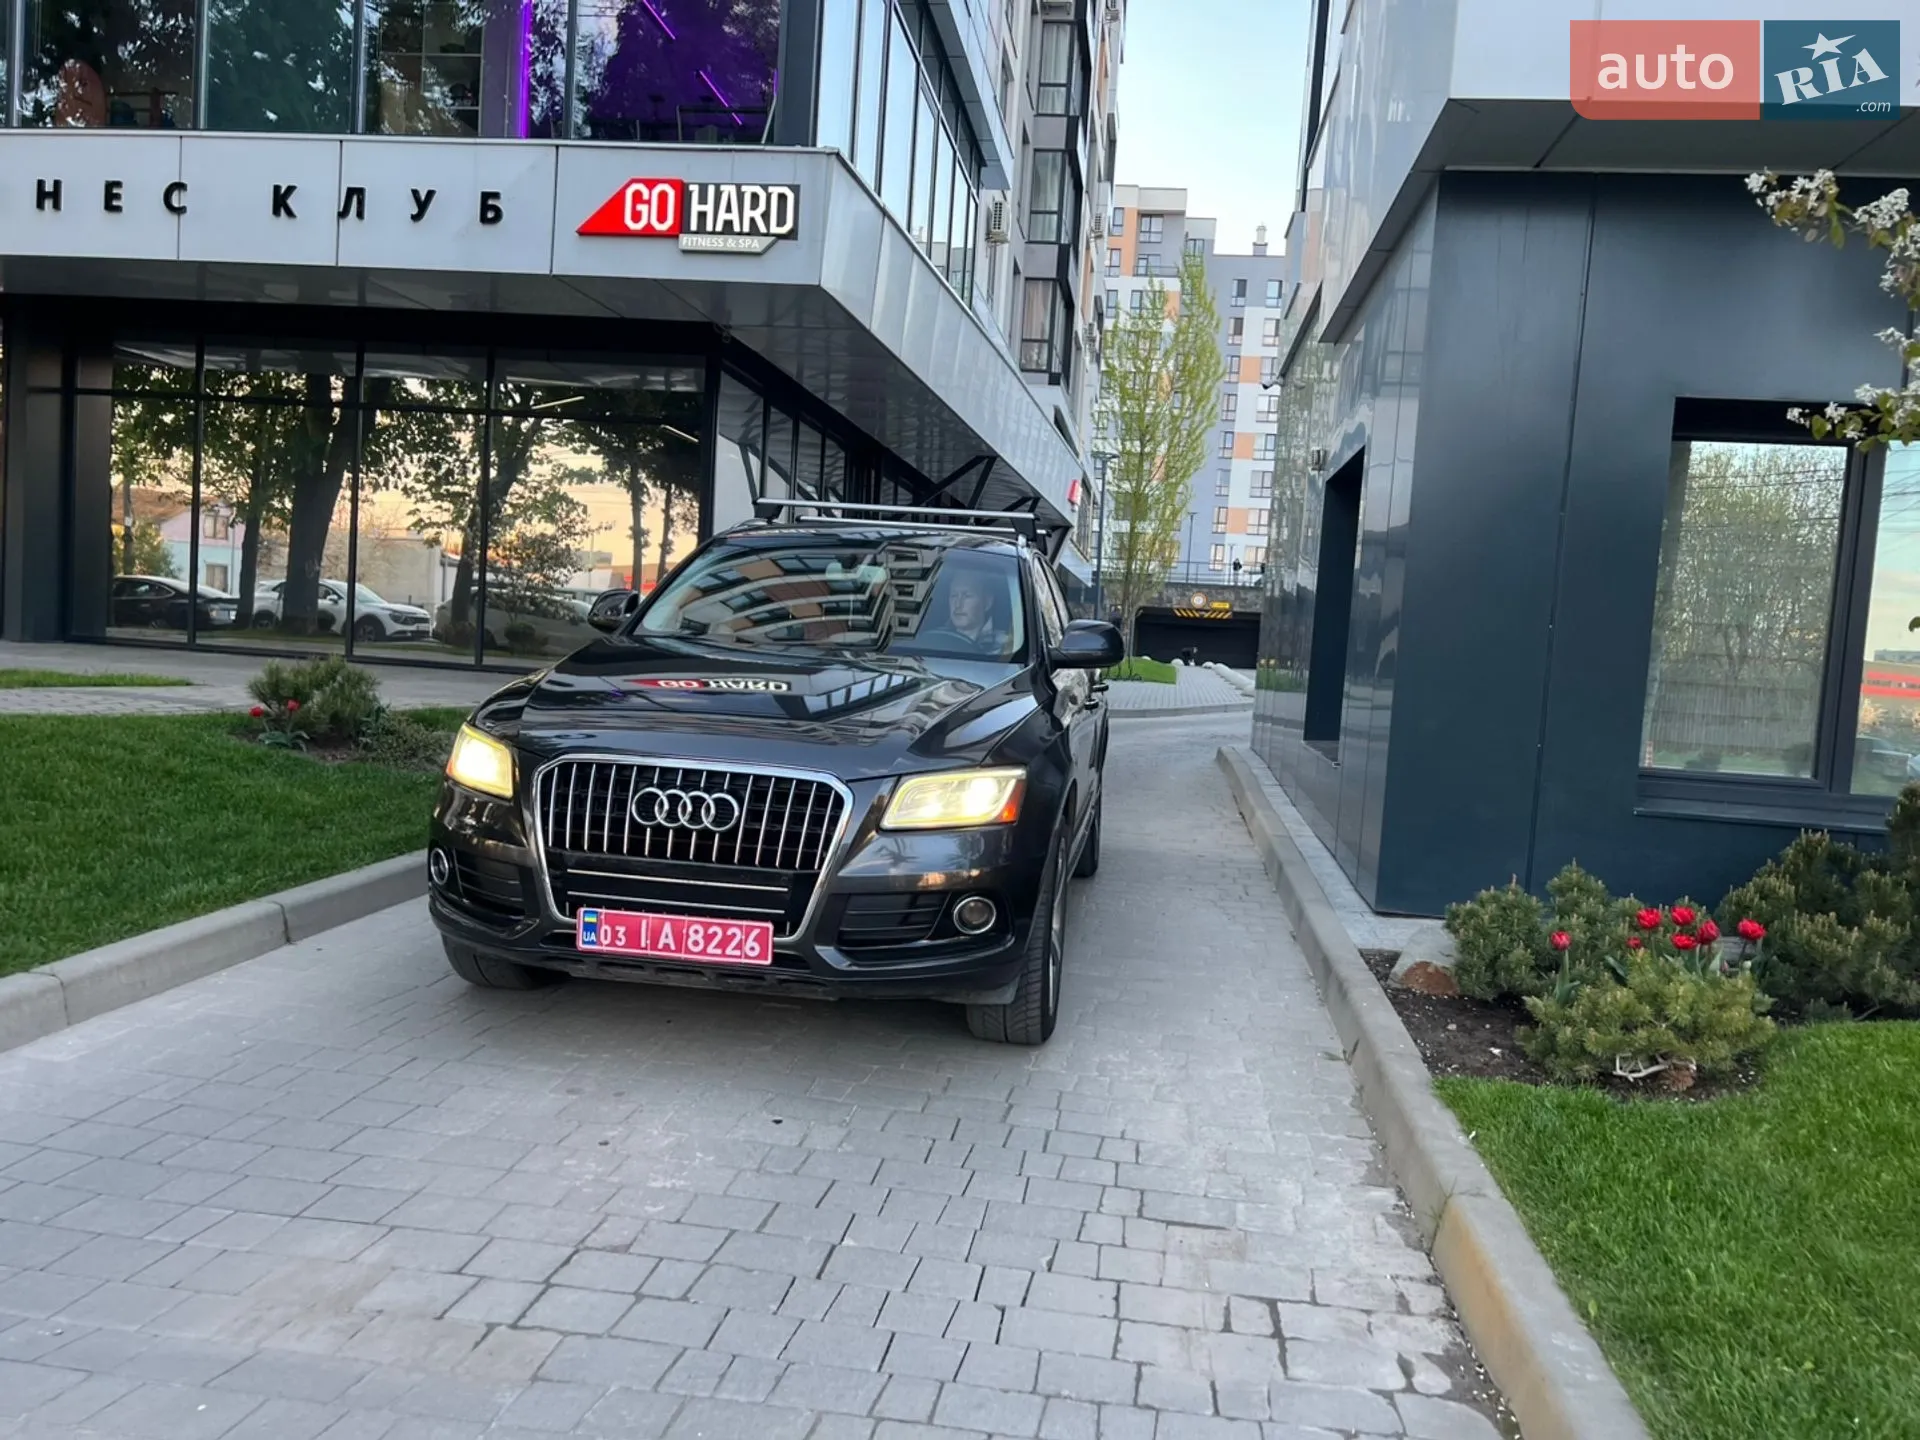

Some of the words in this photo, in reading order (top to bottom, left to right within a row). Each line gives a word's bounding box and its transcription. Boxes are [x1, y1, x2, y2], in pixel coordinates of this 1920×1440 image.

[36, 178, 188, 215] НЕС
[271, 184, 504, 226] КЛУБ
[624, 182, 676, 231] GO
[688, 184, 795, 235] HARD
[682, 237, 724, 248] FITNESS
[726, 238, 737, 248] &
[738, 238, 760, 249] SPA
[583, 931, 597, 942] UA
